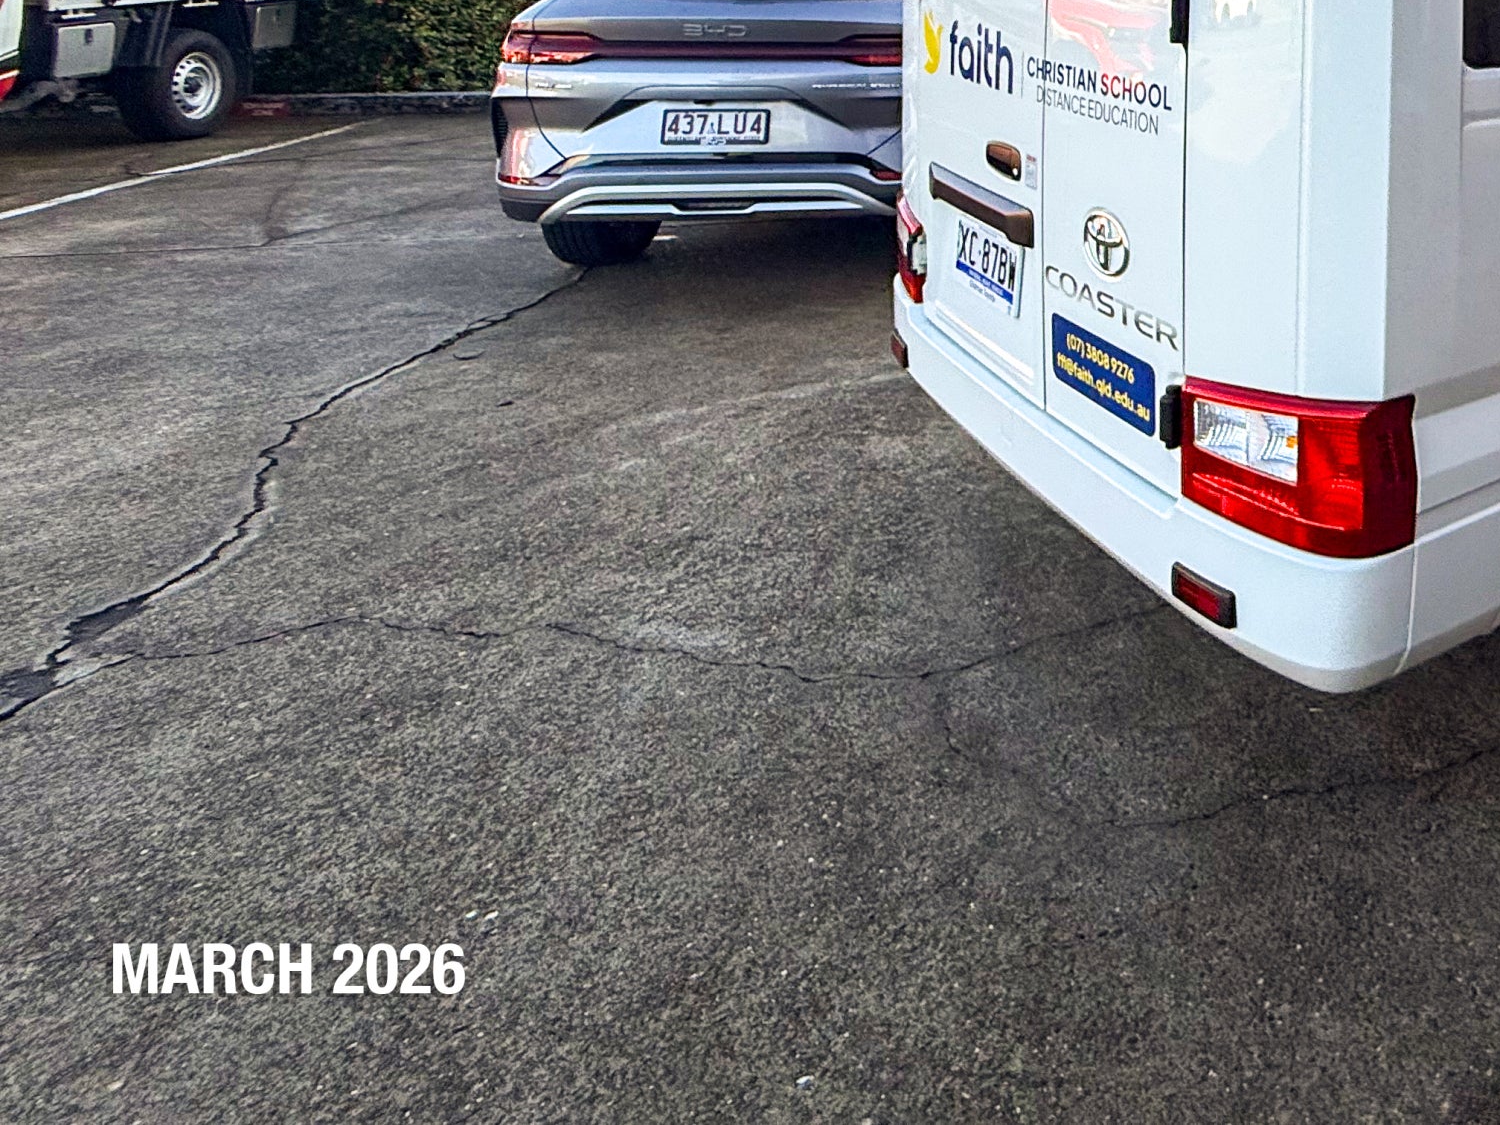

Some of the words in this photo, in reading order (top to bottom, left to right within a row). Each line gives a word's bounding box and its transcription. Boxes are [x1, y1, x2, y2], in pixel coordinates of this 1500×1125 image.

[950, 19, 1013, 94] faith
[1026, 56, 1096, 94] CHRISTIAN
[1101, 72, 1172, 111] SCHOOL
[1036, 85, 1091, 116] DISTANCE
[1088, 101, 1159, 136] EDUCATION
[1045, 265, 1179, 351] COASTER
[1066, 333, 1085, 359] (07)
[1086, 342, 1110, 370] 3808
[1110, 357, 1136, 384] 9276
